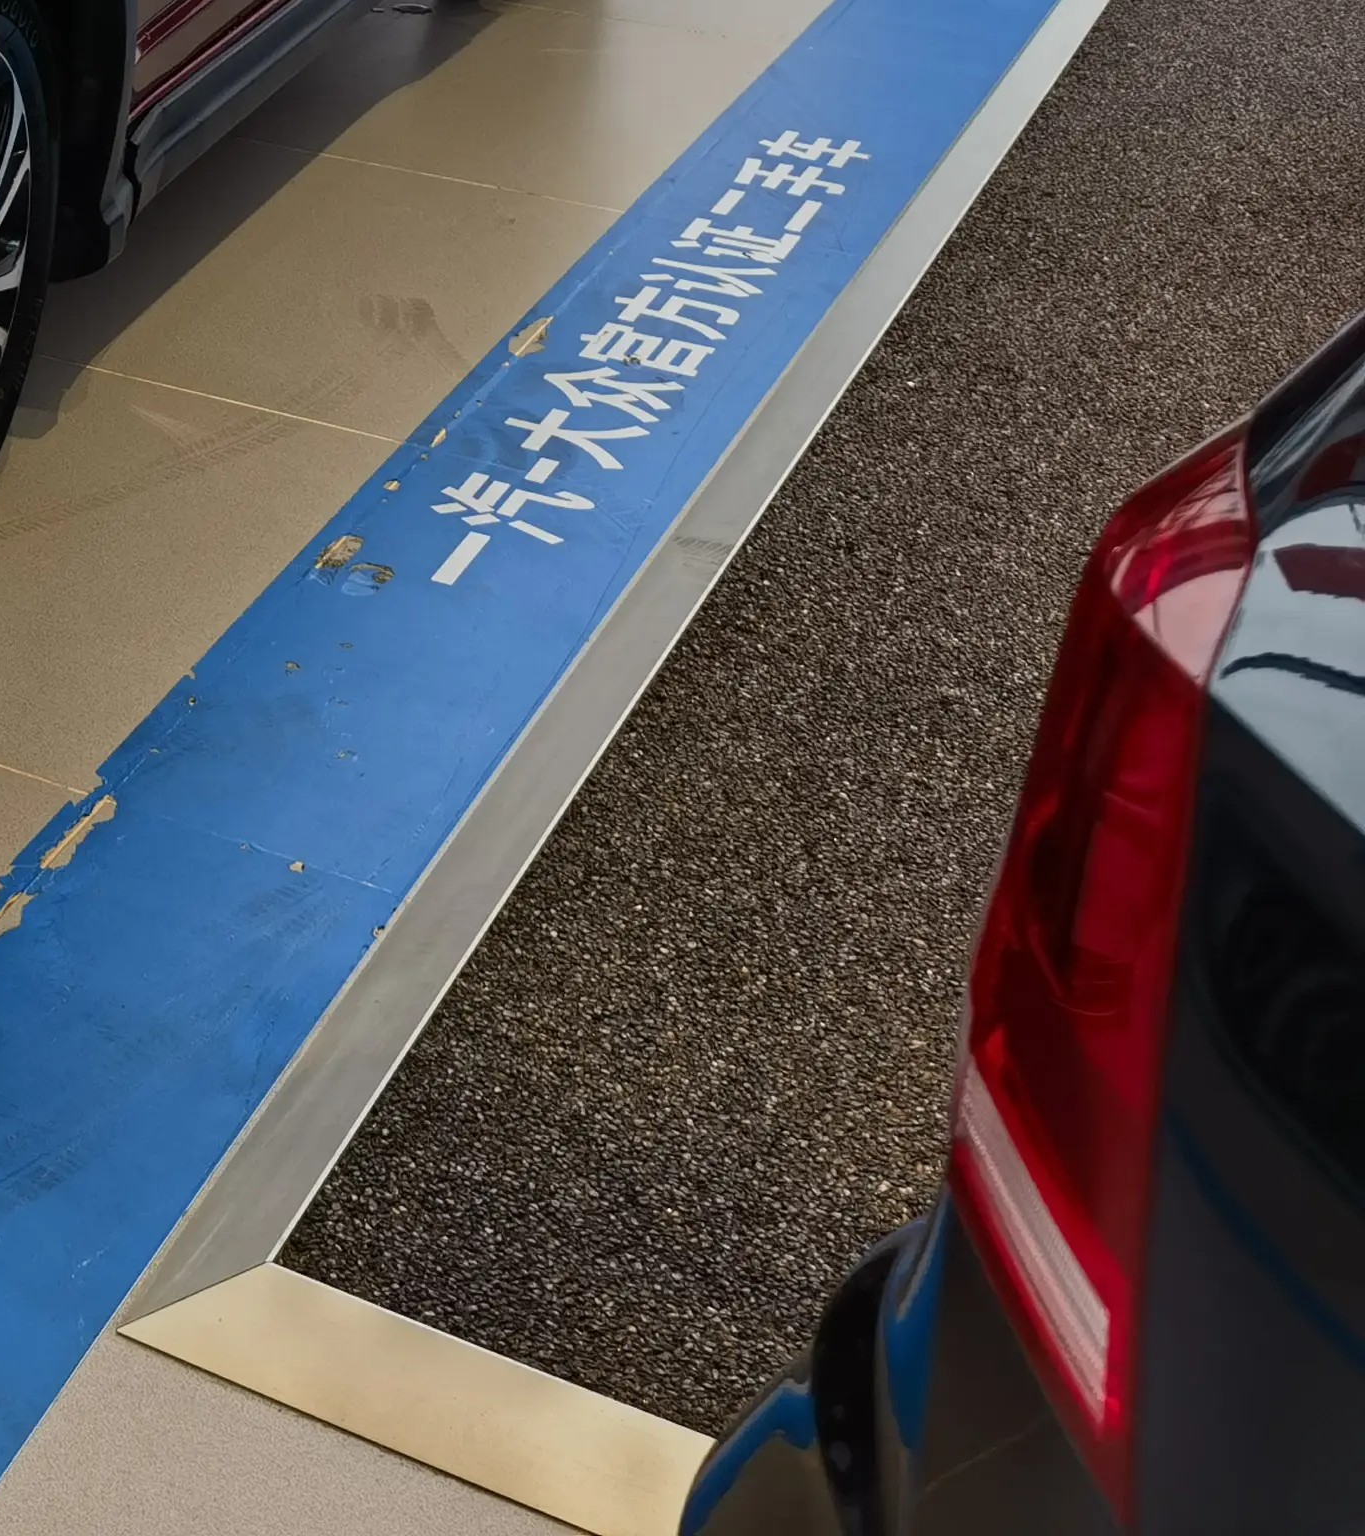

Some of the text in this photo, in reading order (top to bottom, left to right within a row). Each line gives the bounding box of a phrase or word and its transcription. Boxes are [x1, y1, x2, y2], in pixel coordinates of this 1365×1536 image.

[430, 130, 871, 586] 一汽-大众官方认证二手车
